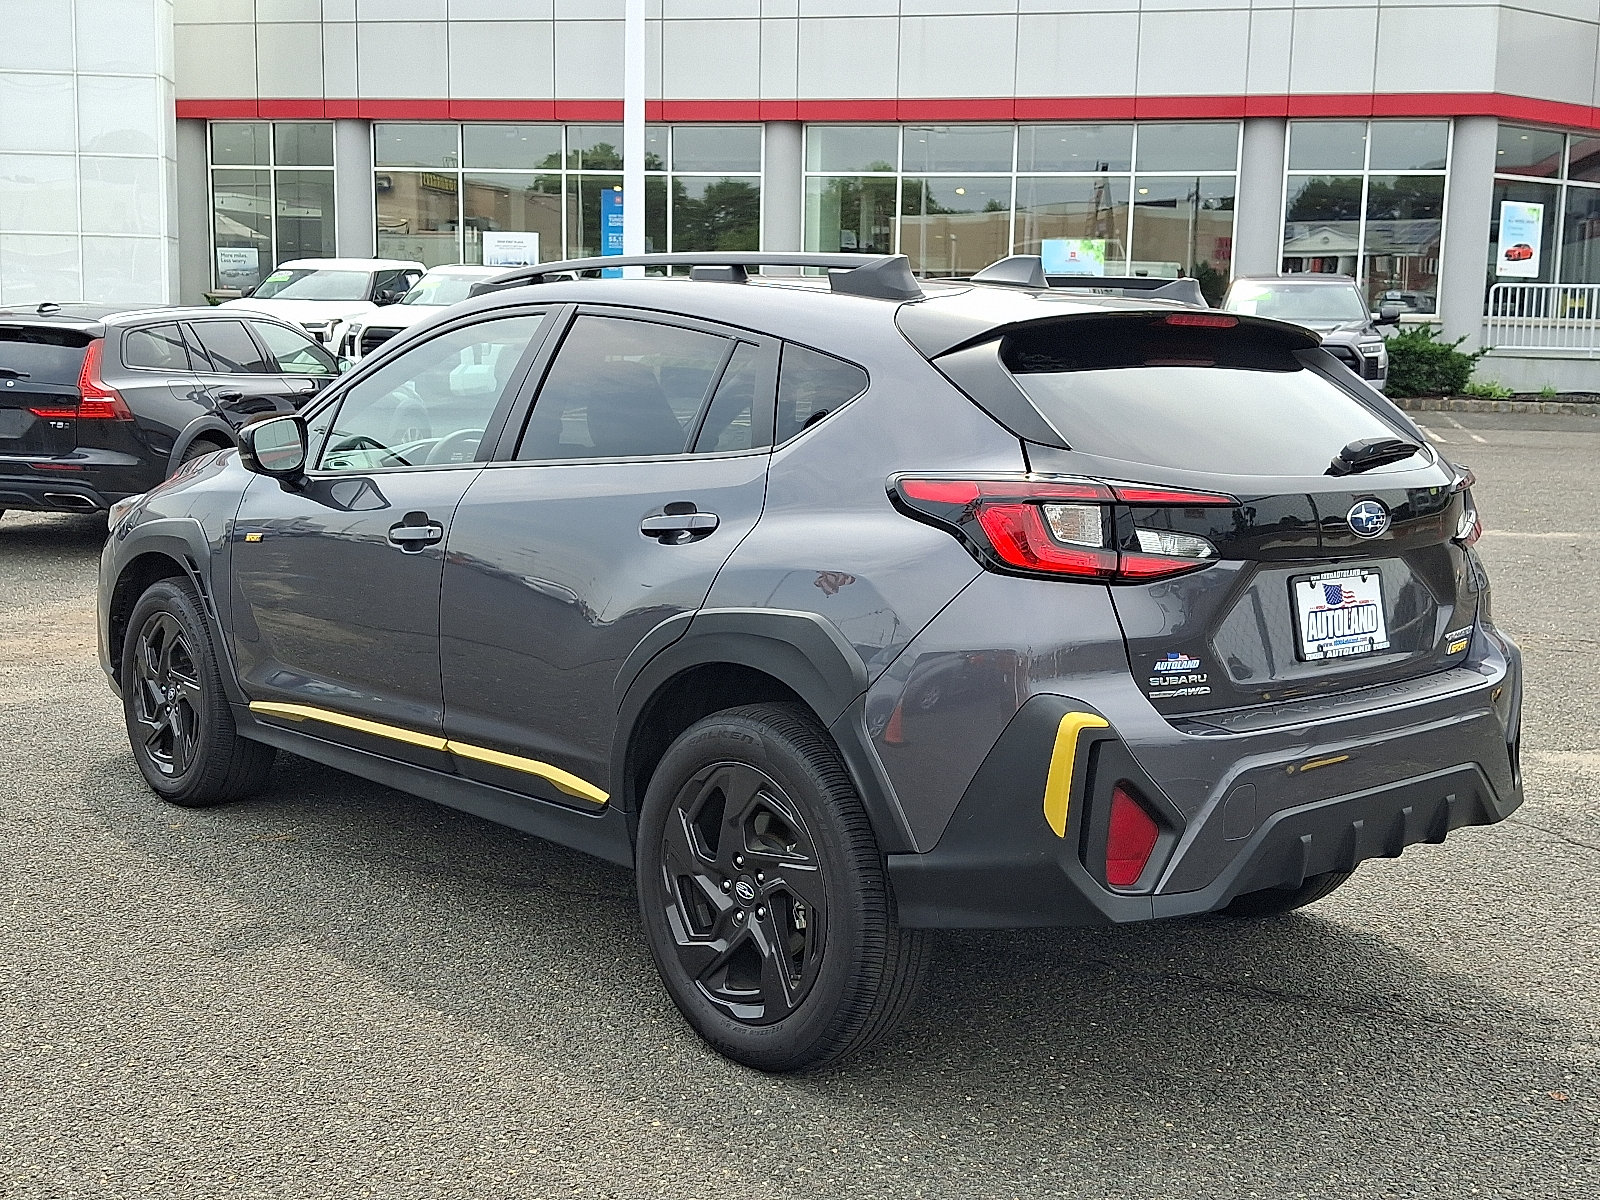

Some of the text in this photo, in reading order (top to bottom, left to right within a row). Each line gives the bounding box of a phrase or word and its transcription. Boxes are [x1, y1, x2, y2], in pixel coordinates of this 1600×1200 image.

[1307, 604, 1378, 642] AUTOLAND
[1326, 643, 1371, 658] AUTOLAND
[1153, 659, 1200, 671] AUTOLAND
[1149, 673, 1208, 686] SUBARU
[1173, 686, 1211, 697] AWD
